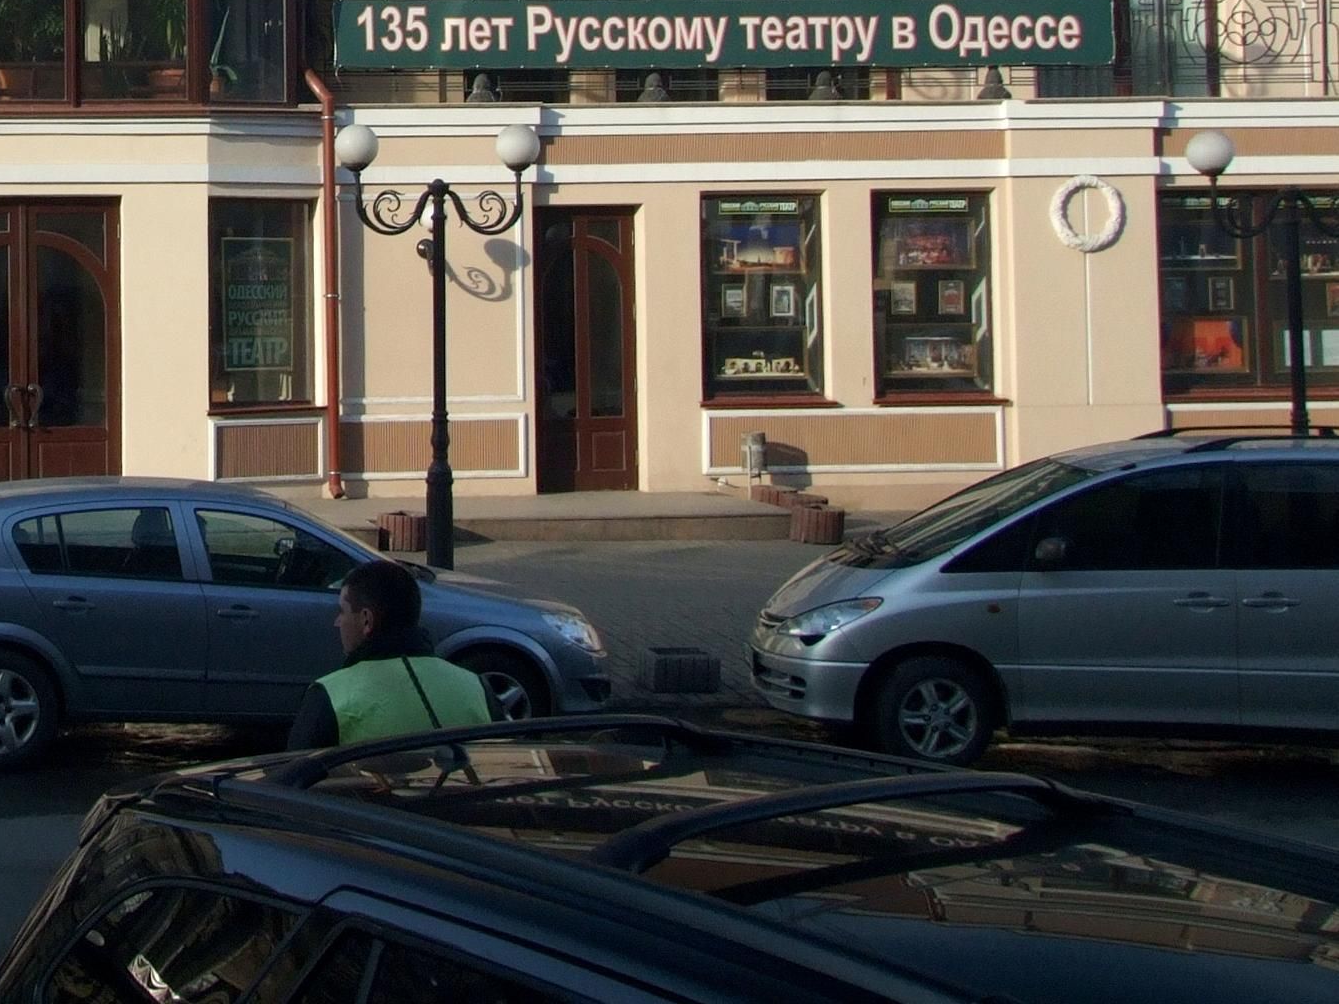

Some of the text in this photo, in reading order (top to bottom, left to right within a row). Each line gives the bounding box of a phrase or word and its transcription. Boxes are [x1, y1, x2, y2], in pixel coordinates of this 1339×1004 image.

[357, 4, 1081, 63] 135 лет Русскому театру в Одессе
[228, 337, 288, 365] ТЕАТР
